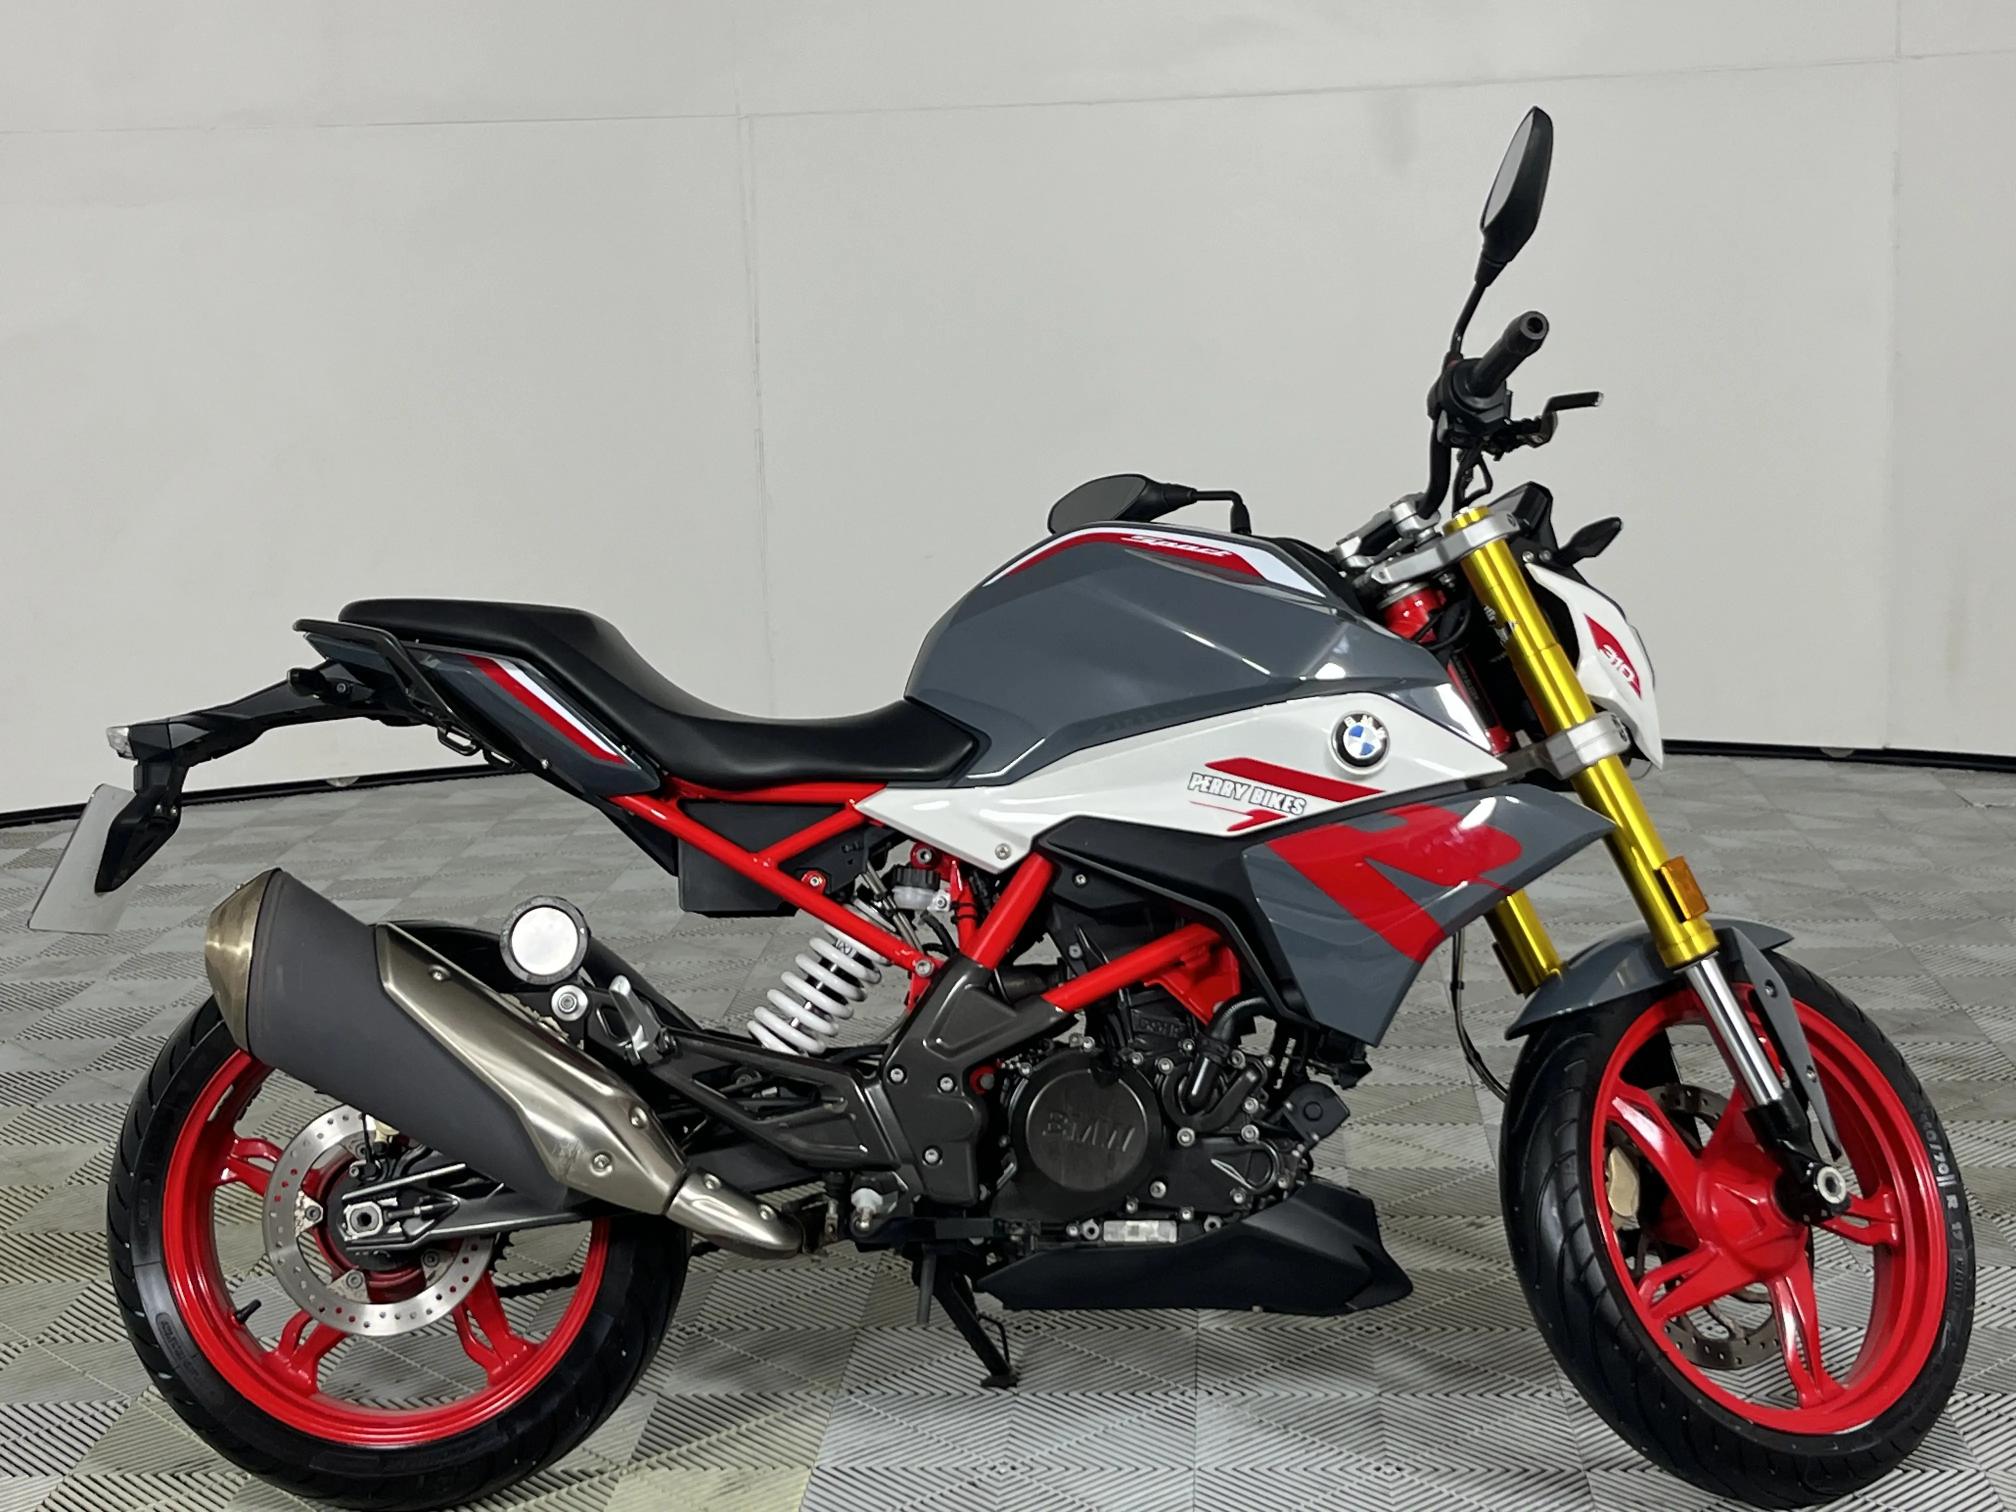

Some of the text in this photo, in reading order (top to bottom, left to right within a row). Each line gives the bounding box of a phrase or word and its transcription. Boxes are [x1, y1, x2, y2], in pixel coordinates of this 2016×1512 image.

[1599, 643, 1636, 682] 310
[1187, 772, 1307, 816] PERRY BIKES
[1041, 1111, 1137, 1153] BMW
